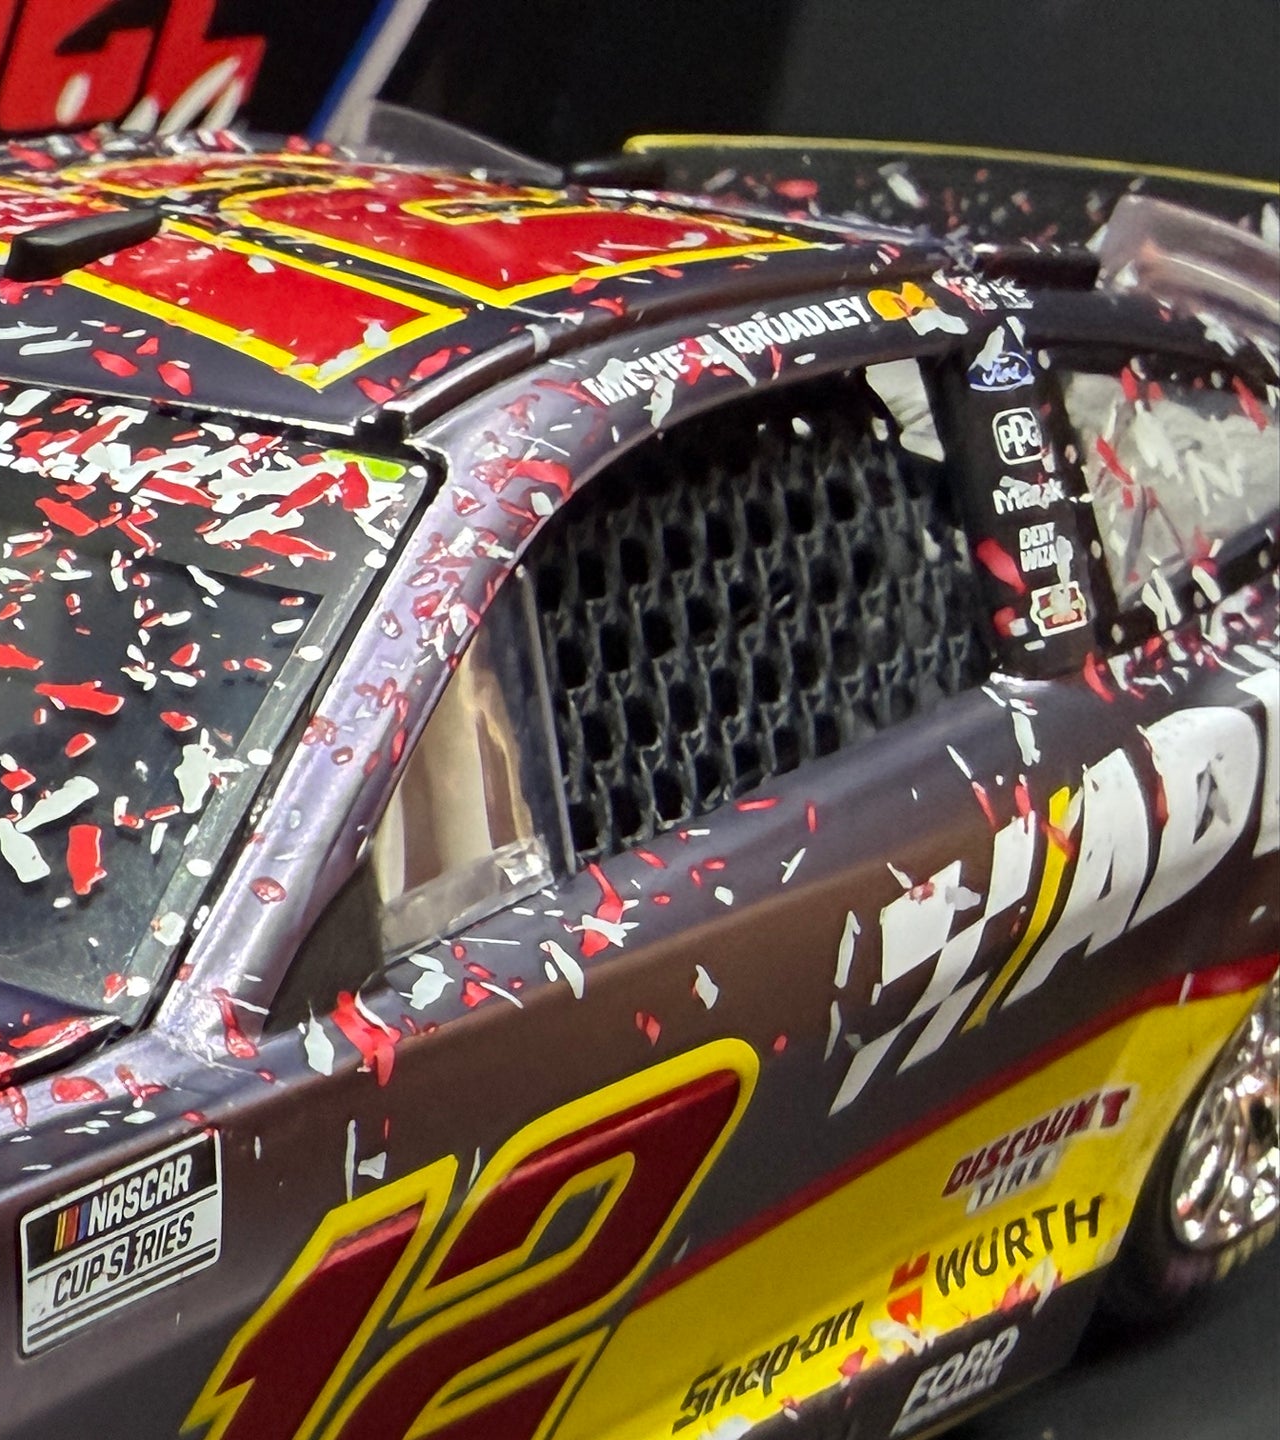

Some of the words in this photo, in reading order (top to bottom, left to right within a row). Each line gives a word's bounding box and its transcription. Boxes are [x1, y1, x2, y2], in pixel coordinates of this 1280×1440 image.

[997, 414, 1042, 457] PPG
[941, 1087, 1132, 1198] DISCOUNT
[87, 1153, 194, 1237] NASCAR
[52, 1252, 105, 1309] CUP
[672, 1301, 865, 1434] Snap-on
